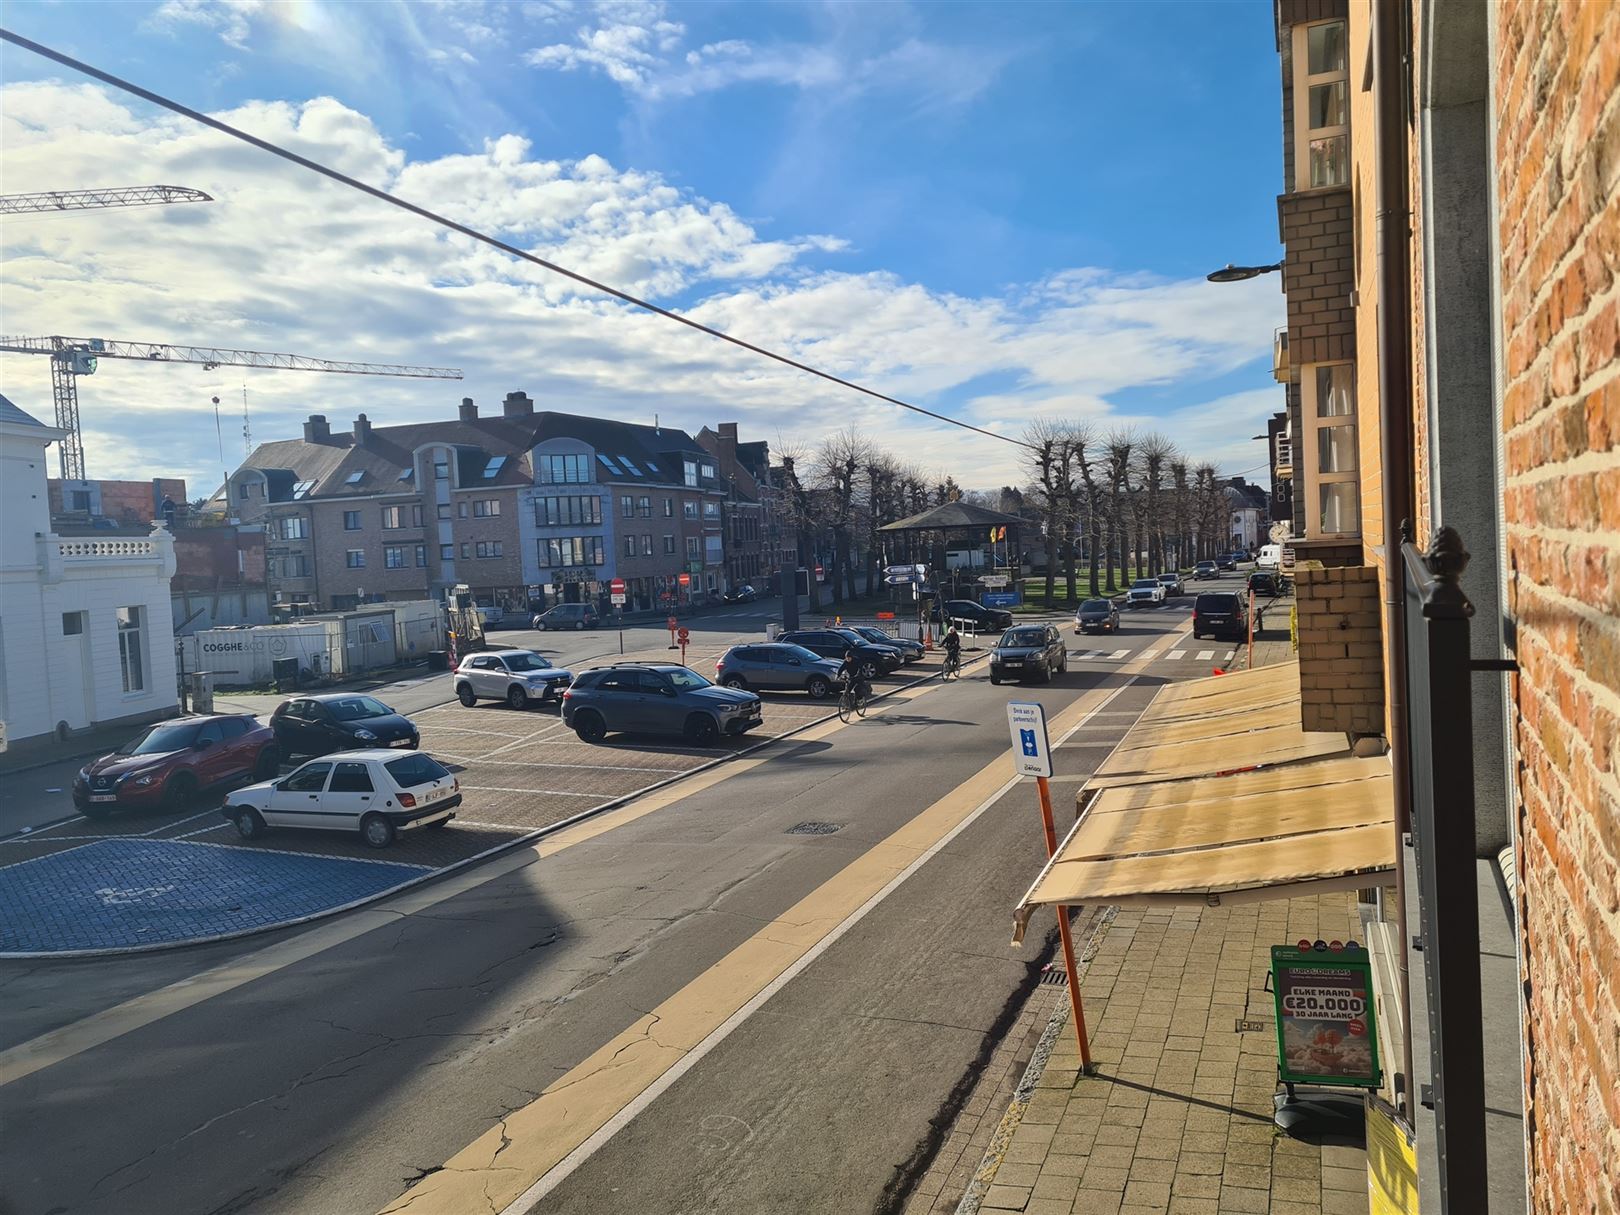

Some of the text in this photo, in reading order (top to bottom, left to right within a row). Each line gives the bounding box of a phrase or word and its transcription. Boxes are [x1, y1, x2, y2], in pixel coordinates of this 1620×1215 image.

[1293, 989, 1351, 997] ELKE MAAND
[1285, 997, 1361, 1012] €20.000
[1330, 1012, 1353, 1020] LANG
